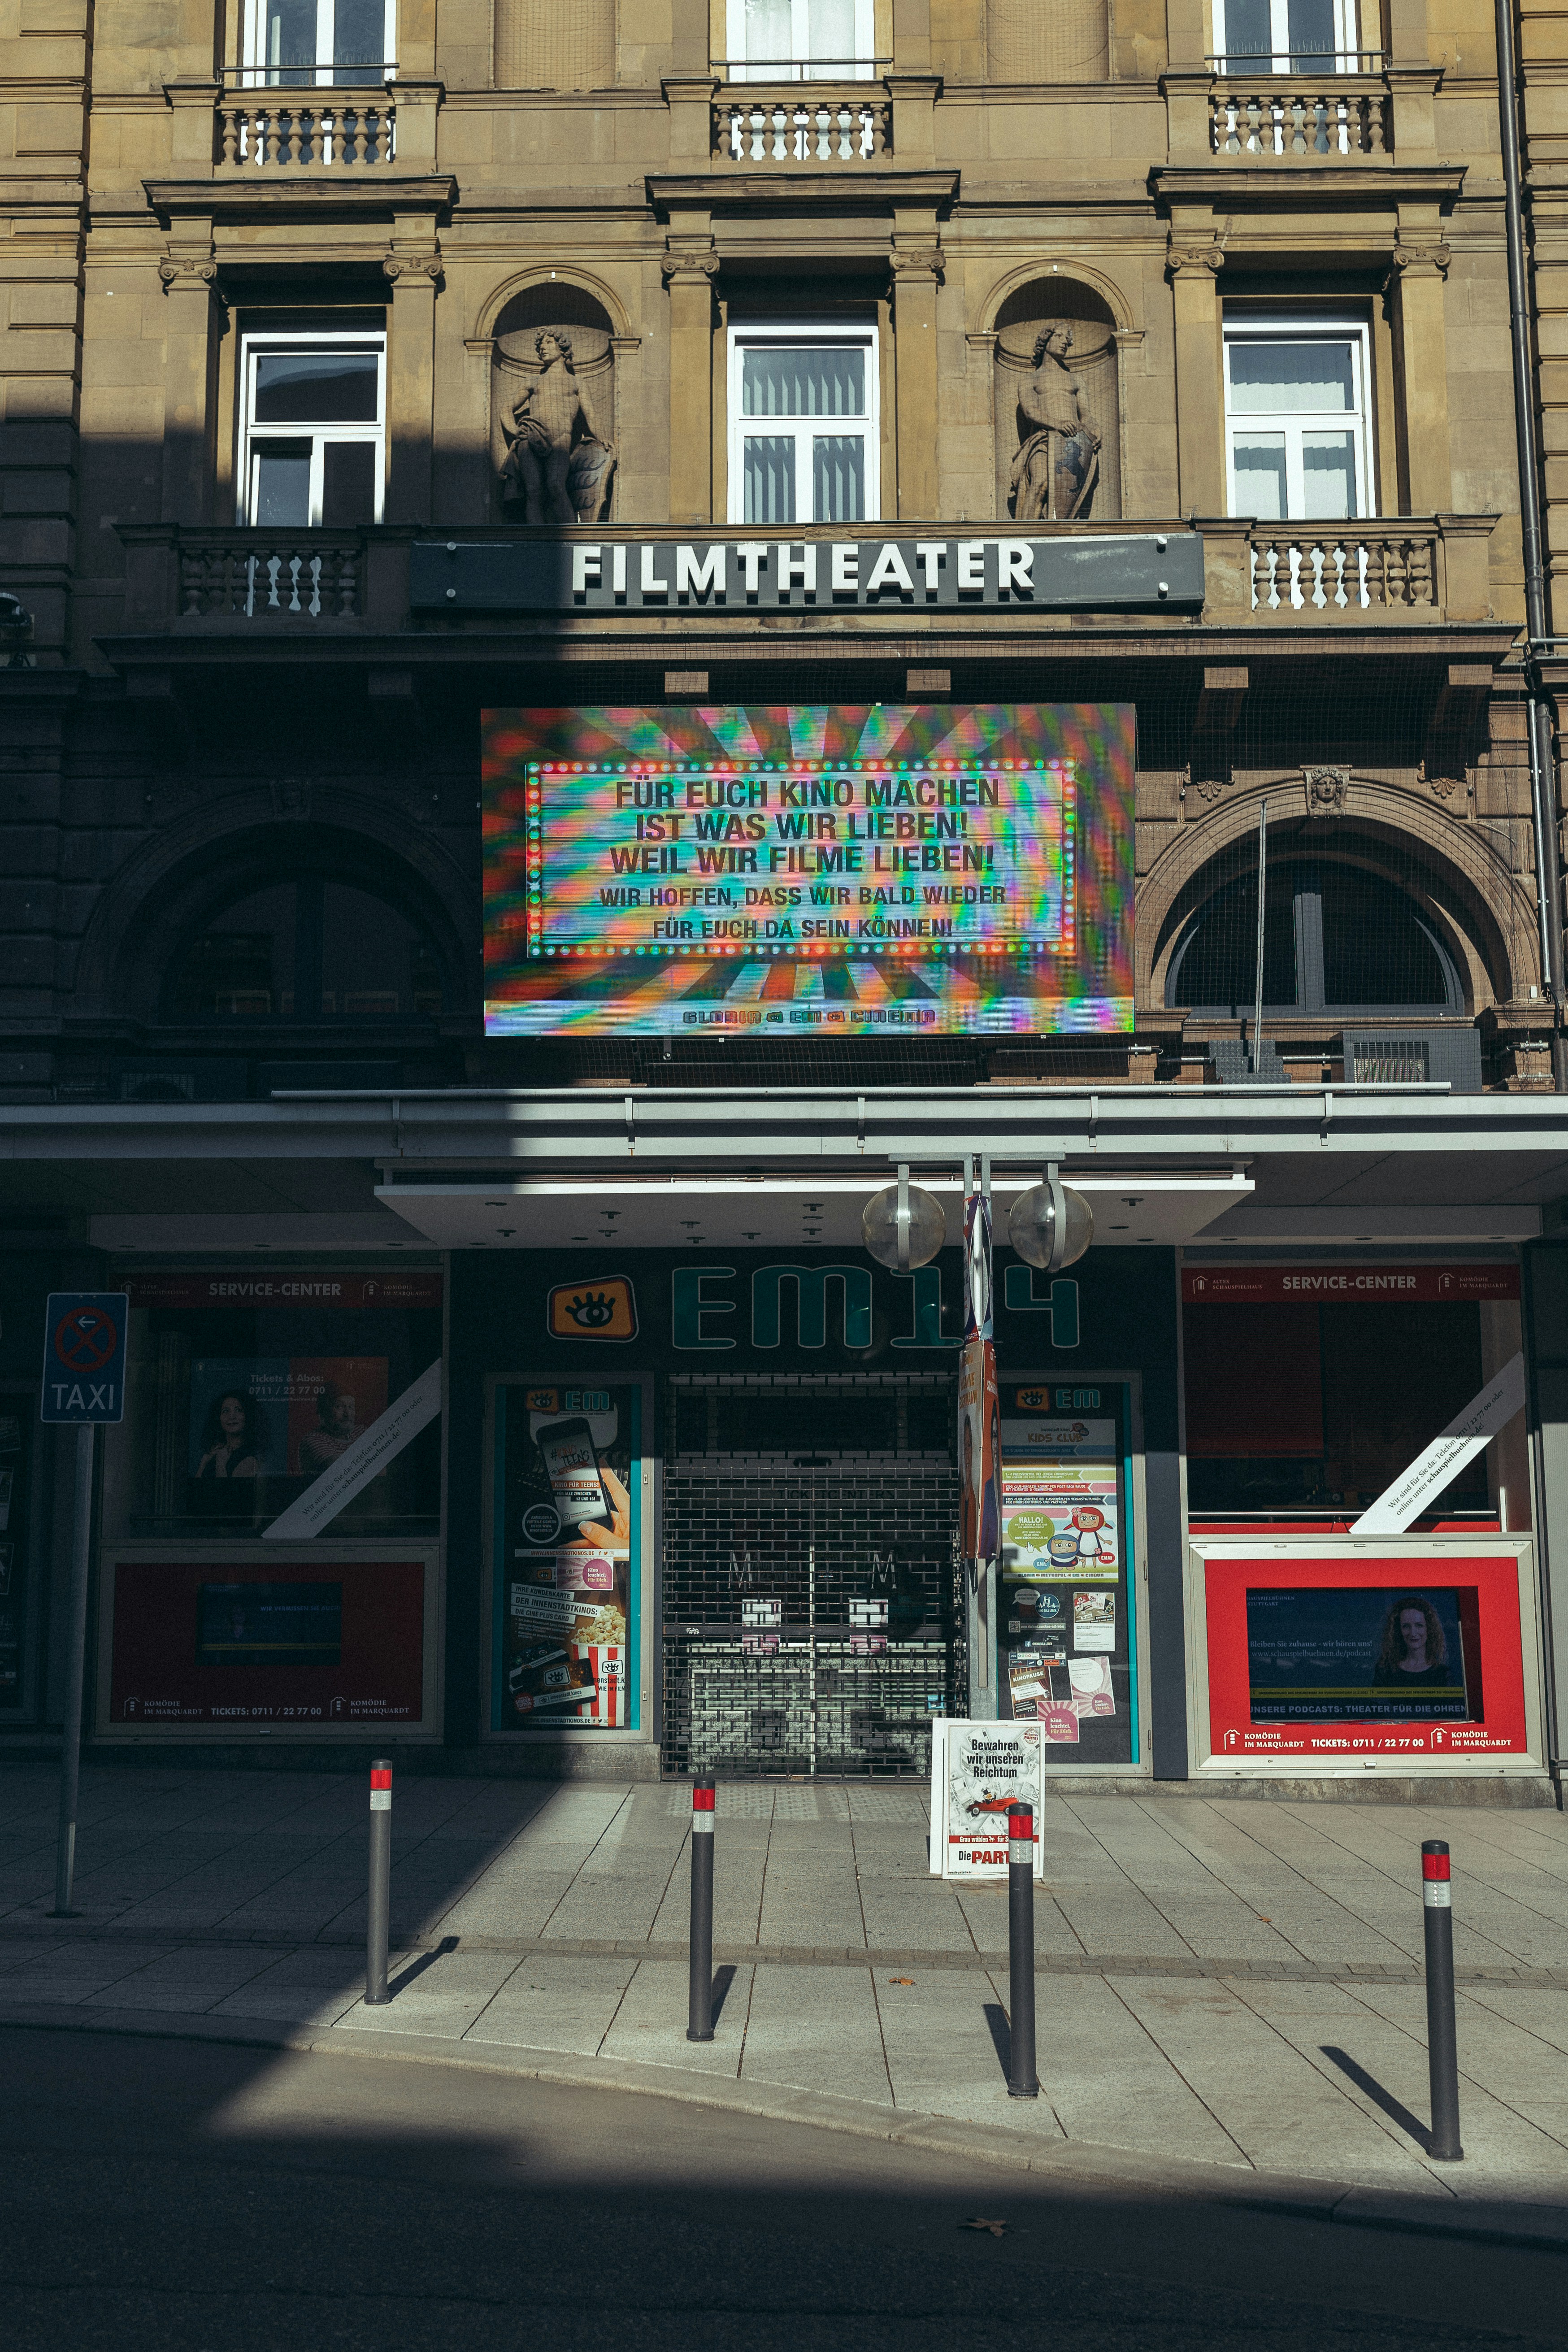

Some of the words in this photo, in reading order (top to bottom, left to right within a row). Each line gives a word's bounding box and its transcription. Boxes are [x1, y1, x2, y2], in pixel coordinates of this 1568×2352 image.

[573, 542, 1035, 602] FILMTHEATER
[616, 776, 674, 808] FÜR
[686, 779, 769, 808] EUCH
[779, 779, 854, 808] KINO
[865, 778, 999, 807] MACHEN
[636, 813, 684, 841] IST
[695, 813, 765, 841] WAS
[777, 813, 836, 841] WIR
[850, 813, 968, 841] LIEBEN!
[610, 846, 687, 874] WEIL
[698, 846, 759, 874] WIR
[770, 846, 863, 874] FILME
[873, 846, 994, 874] LIEBEN!
[600, 887, 642, 907] WIR
[650, 887, 738, 909] HOFFEN,
[745, 887, 803, 907] DASS
[810, 887, 851, 907] WIR
[858, 887, 915, 907] BALD
[923, 887, 1006, 907] WIEDER
[653, 917, 693, 939] FÜR
[702, 920, 757, 939] EUCH
[764, 920, 794, 939] DA
[801, 920, 849, 939] SEIN
[857, 916, 952, 939] KÖNNEN!
[683, 1011, 761, 1024] GLORIA
[789, 1011, 821, 1024] EM
[851, 1011, 936, 1024] CINEMA
[1282, 1276, 1416, 1289] SERVICE-CENTER
[208, 1283, 341, 1296] SERVICE-CENTER
[251, 1374, 283, 1383] Tickets
[287, 1374, 293, 1383] &
[297, 1374, 324, 1383] Abos:
[51, 1384, 114, 1410] TAXI
[249, 1387, 273, 1395] 0711
[276, 1387, 280, 1395] /
[284, 1387, 295, 1395] 22
[300, 1387, 311, 1395] 77
[314, 1387, 326, 1395] 00
[565, 1391, 609, 1410] EM
[1056, 1389, 1100, 1409] EM
[1028, 1433, 1053, 1443] KIDS
[1057, 1433, 1084, 1443] CLUB
[1388, 1496, 1400, 1509] Wir
[1401, 1484, 1412, 1497] sind
[1411, 1476, 1420, 1486] für
[1419, 1468, 1429, 1478] Sie
[1428, 1459, 1437, 1469] da:
[1435, 1439, 1456, 1461] Telefon
[1455, 1428, 1468, 1440] 0711
[1471, 1417, 1478, 1425] 22
[1477, 1410, 1485, 1420] 77
[1491, 1389, 1504, 1403] oder
[561, 1449, 590, 1467] TEENS
[1397, 1497, 1414, 1516] online
[1414, 1482, 1427, 1498] unter
[1427, 1422, 1484, 1484] schauspielbuehnen.de!
[530, 1588, 570, 1599] KUNDENKARTE
[531, 1599, 598, 1615] INNENSTADTKINOS:
[1252, 1650, 1371, 1658] www.schauspielbuehnen.de/podcast
[1013, 1671, 1044, 1682] KINOPAUSE
[1393, 1703, 1412, 1713] FÜR
[972, 1739, 1019, 1751] Bewahren
[1311, 1739, 1350, 1748] TICKETS:
[1352, 1739, 1374, 1748] 0711
[1377, 1739, 1381, 1748] /
[1385, 1739, 1396, 1748] 22
[1399, 1739, 1410, 1748] 77
[1412, 1739, 1424, 1748] 00
[1451, 1739, 1461, 1747] IM
[1463, 1739, 1511, 1747] MARQUARDT
[967, 1752, 983, 1764] wir
[986, 1755, 1023, 1764] unseren
[973, 1766, 1017, 1778] Reichtum
[959, 1851, 971, 1861] Die
